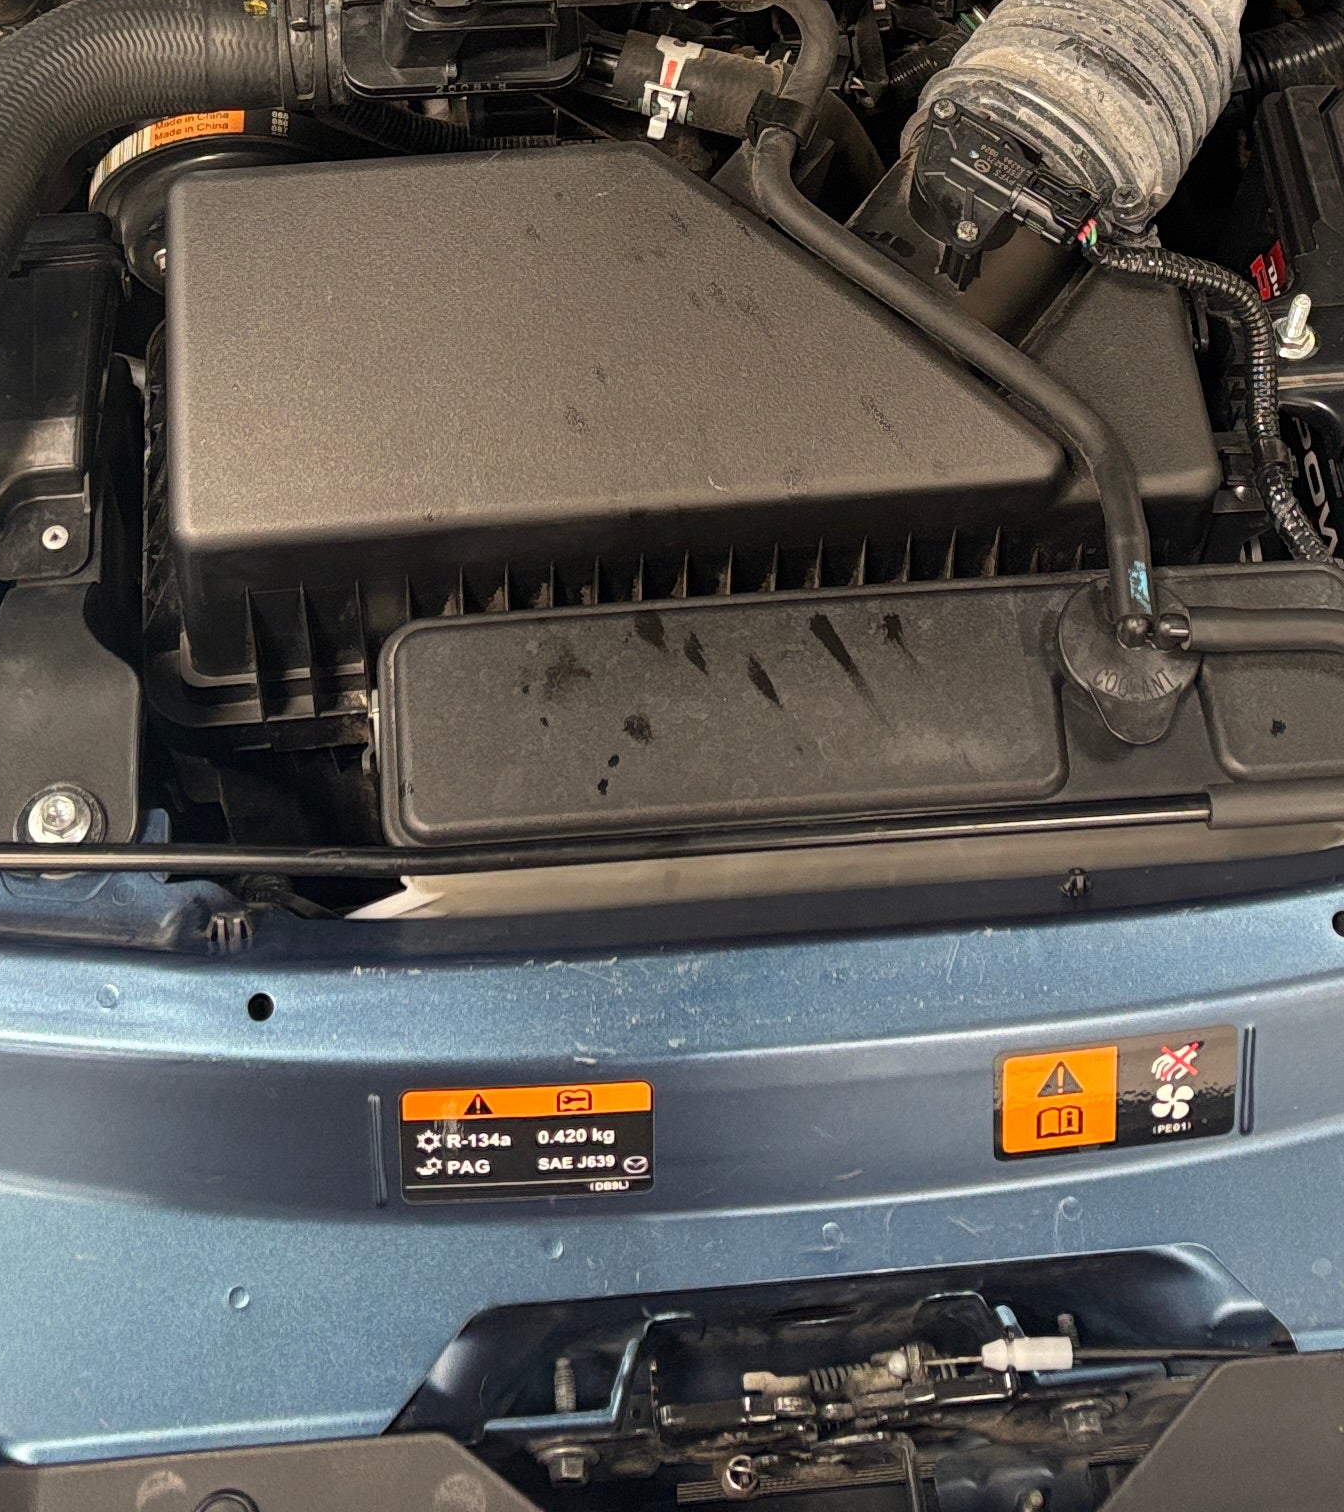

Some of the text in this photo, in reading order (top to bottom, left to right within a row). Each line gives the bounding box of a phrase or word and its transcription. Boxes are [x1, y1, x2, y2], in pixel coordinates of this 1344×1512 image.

[154, 118, 182, 130] Made
[154, 122, 229, 141] Made in China
[1152, 1121, 1192, 1135] (PE01)
[446, 1127, 616, 1149] R-134a 0.420 kg
[447, 1155, 615, 1175] PAG SAE J639
[589, 1180, 630, 1192] (DB9L)
